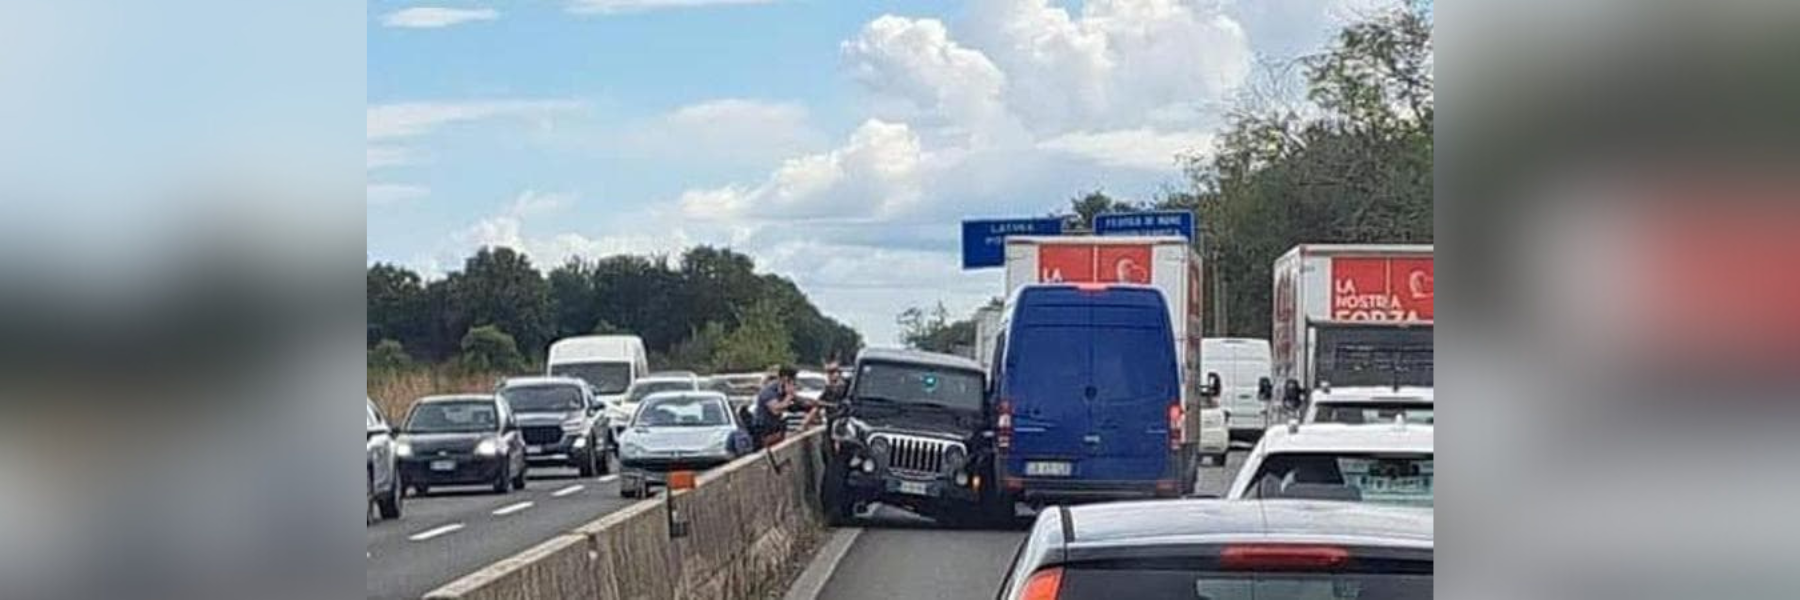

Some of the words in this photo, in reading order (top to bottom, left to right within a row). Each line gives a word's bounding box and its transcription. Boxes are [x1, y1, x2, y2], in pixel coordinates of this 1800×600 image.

[1043, 267, 1063, 282] LA
[1336, 279, 1355, 293] LA
[1336, 294, 1401, 309] NOSTRA
